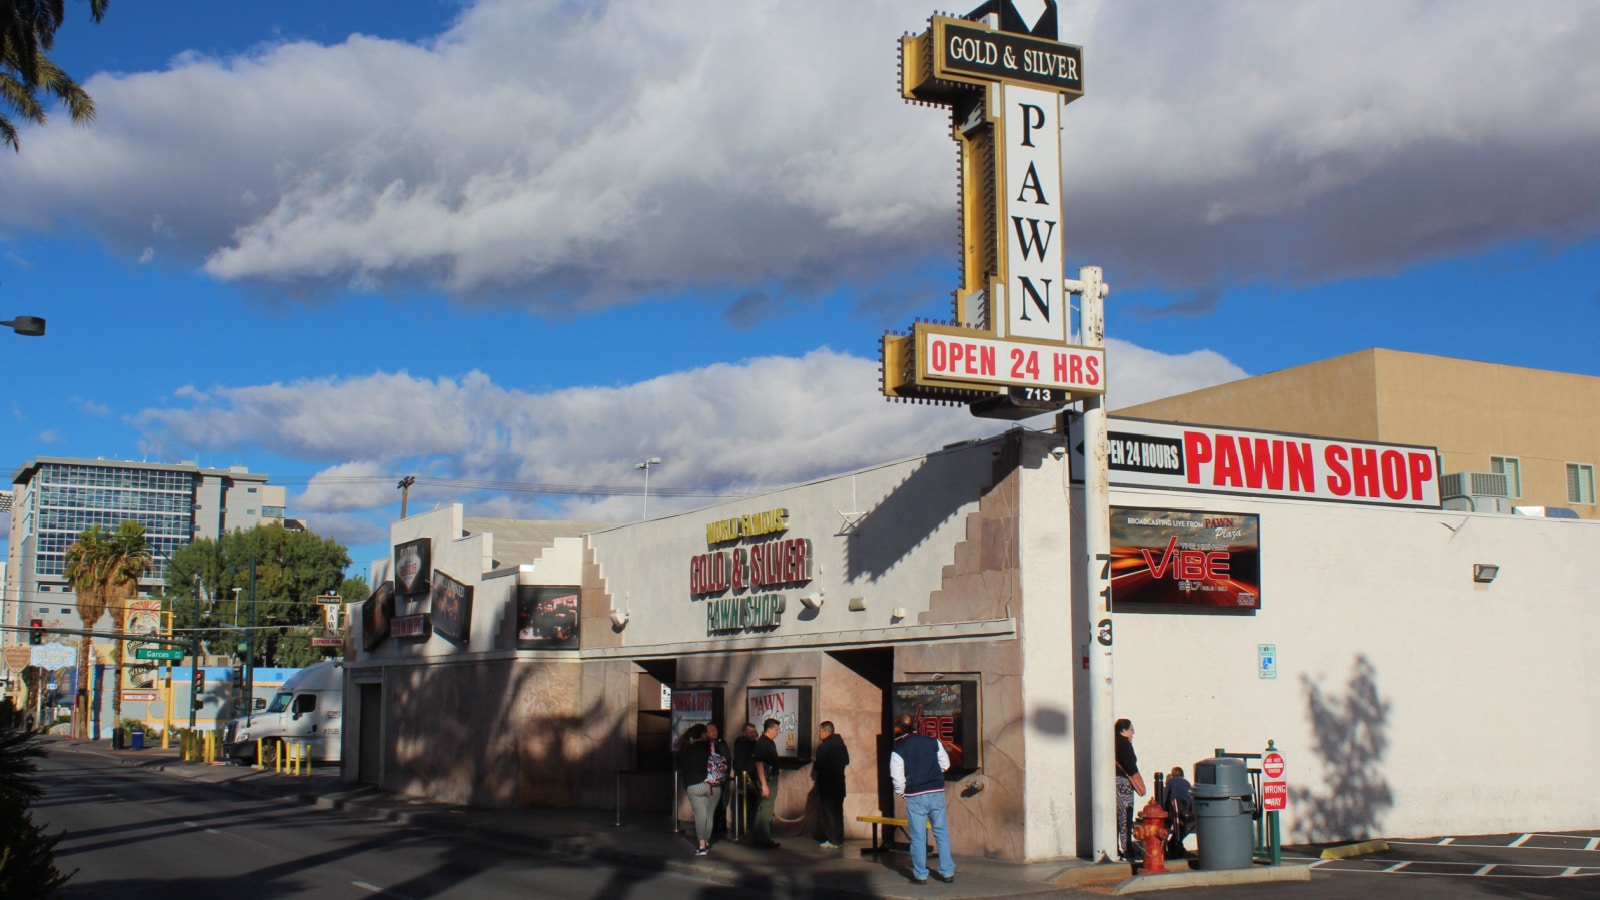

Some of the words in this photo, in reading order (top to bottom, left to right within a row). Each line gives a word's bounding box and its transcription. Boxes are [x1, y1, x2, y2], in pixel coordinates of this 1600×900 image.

[950, 35, 998, 66] GOLD
[1003, 45, 1018, 70] &
[1023, 49, 1079, 81] SILVER
[1010, 102, 1057, 324] PAWN
[932, 340, 996, 376] OPEN
[1010, 348, 1040, 380] 24
[1053, 352, 1099, 386] HRS
[1025, 387, 1051, 402] 713
[1107, 439, 1125, 465] PEN
[1126, 441, 1141, 466] 24
[1141, 442, 1180, 470] HOURS
[1183, 430, 1316, 493] PAWN
[1324, 443, 1434, 501] SHOP
[706, 517, 739, 544] WORLD
[741, 508, 784, 537] FAMOUS
[1127, 517, 1172, 527] BROADCASTING
[1172, 519, 1186, 527] LIVE
[1204, 517, 1234, 529] PAWN
[1215, 527, 1242, 540] Plaza
[690, 551, 726, 594] GOLD
[732, 547, 745, 589] &
[750, 537, 807, 587] SILVER
[706, 597, 742, 631] PAWN
[744, 593, 780, 629] SHOP
[146, 650, 169, 658] Garces
[750, 692, 785, 717] PAWN
[1264, 785, 1286, 794] WRONG
